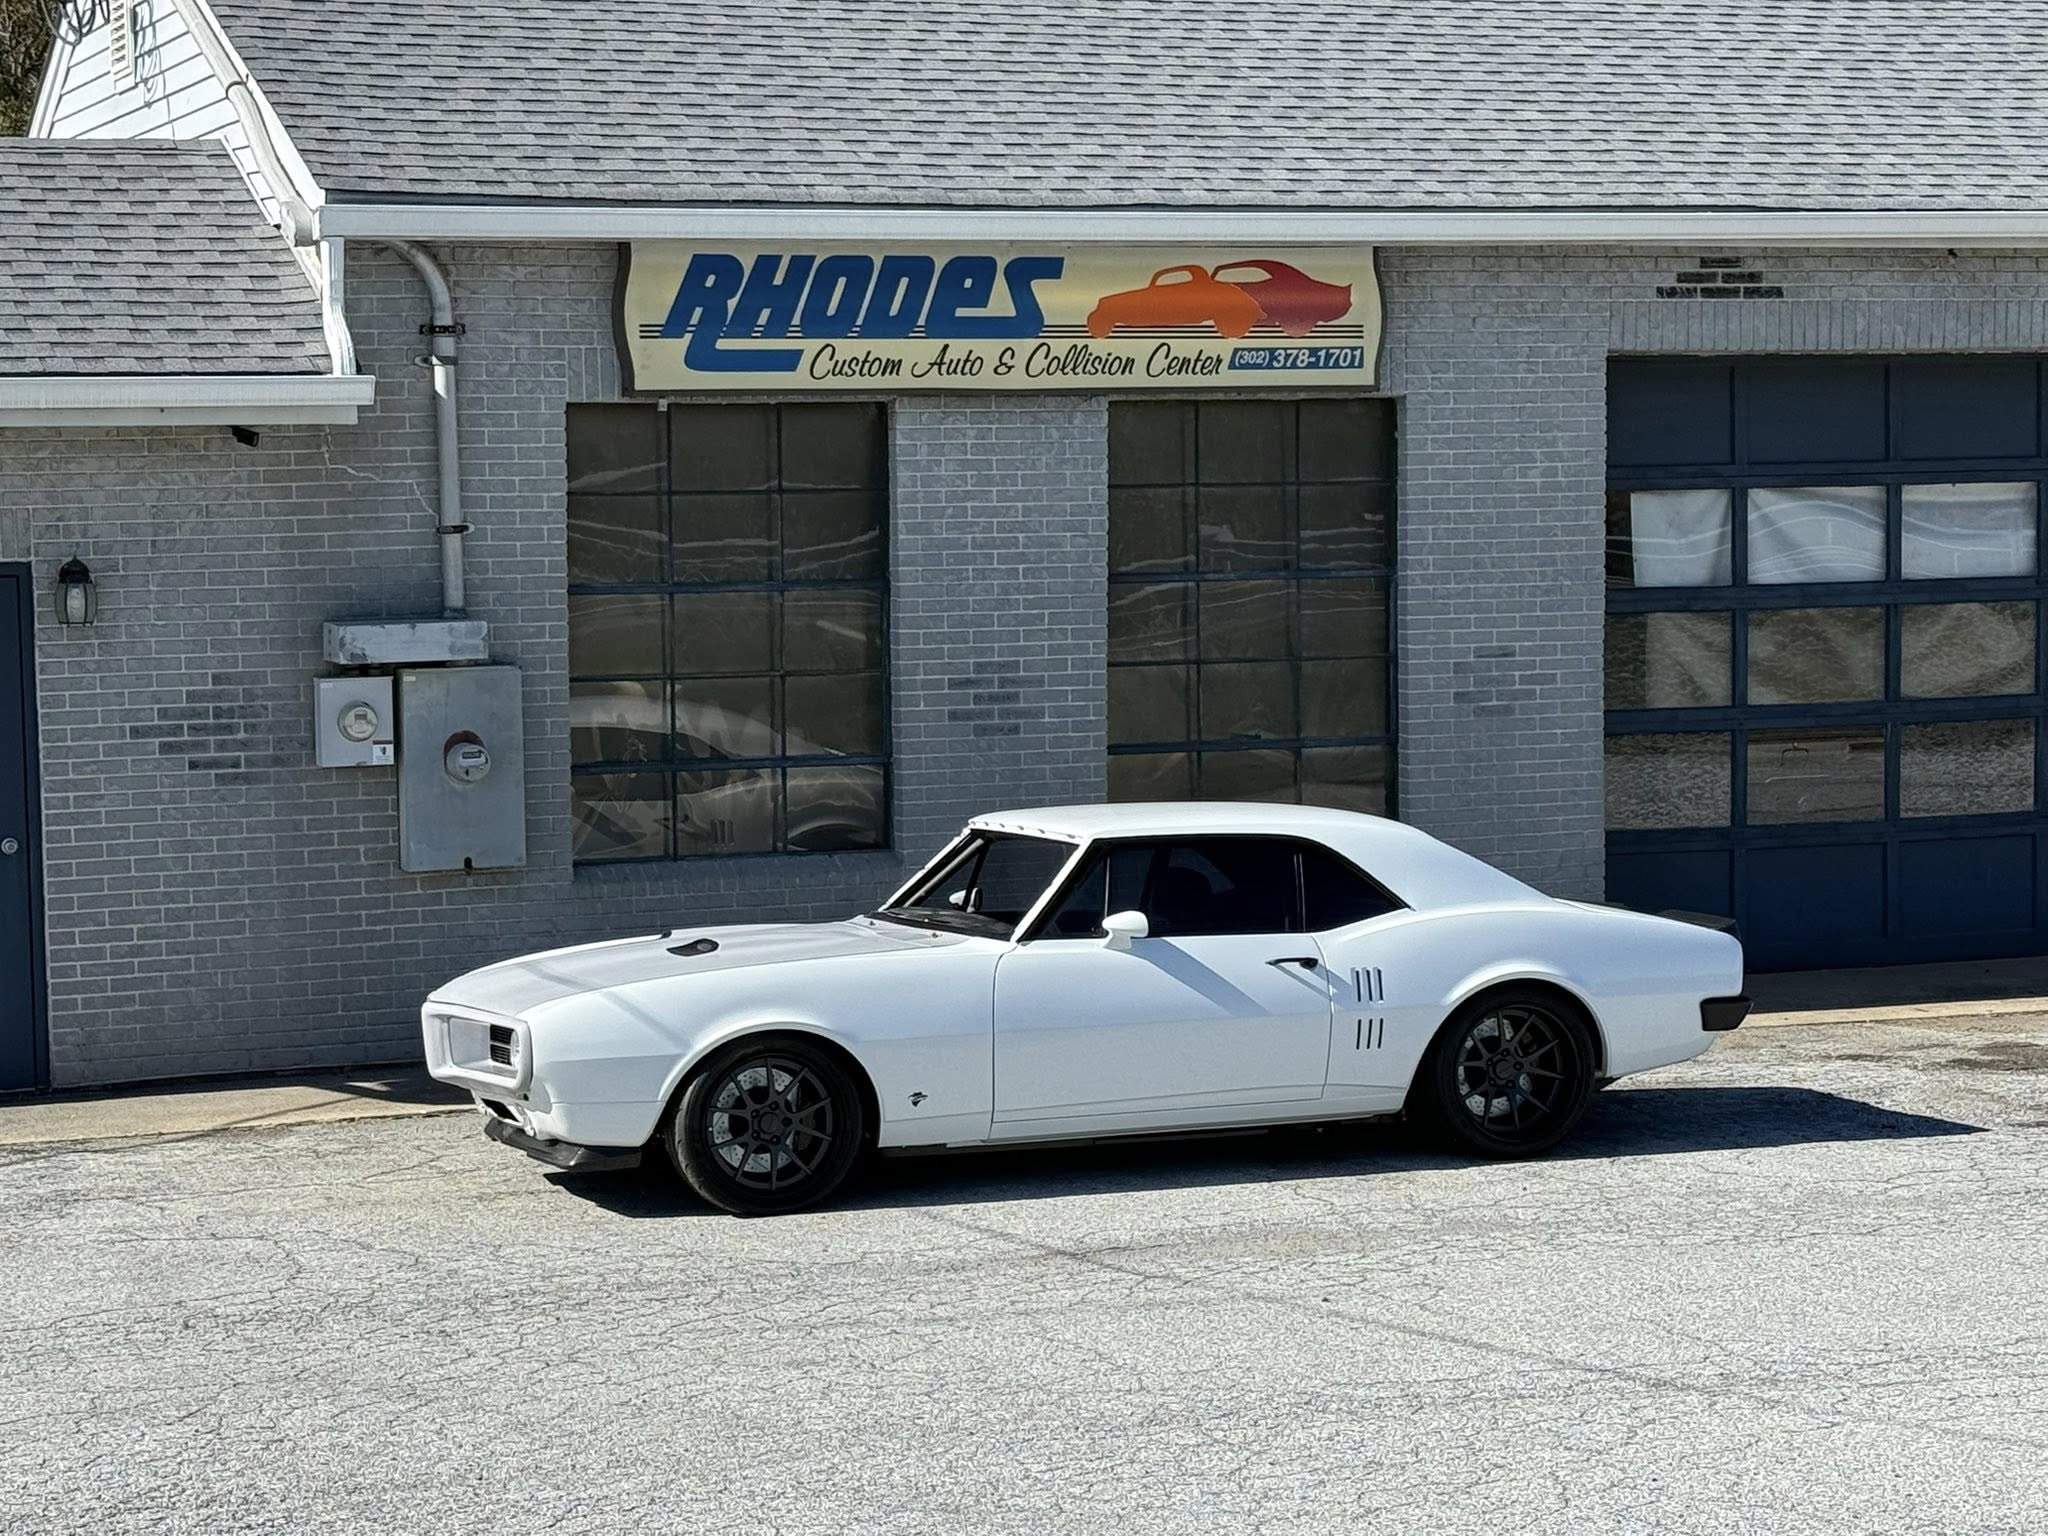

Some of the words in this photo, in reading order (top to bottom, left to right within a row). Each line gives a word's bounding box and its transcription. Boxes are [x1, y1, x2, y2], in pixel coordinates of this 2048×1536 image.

[809, 343, 903, 380] Custom
[911, 343, 984, 379] Auto
[992, 346, 1015, 375] &
[1025, 342, 1136, 377] Collision
[1146, 342, 1223, 377] Center
[1234, 350, 1270, 367] (302)
[1272, 347, 1362, 369] 378-1701
